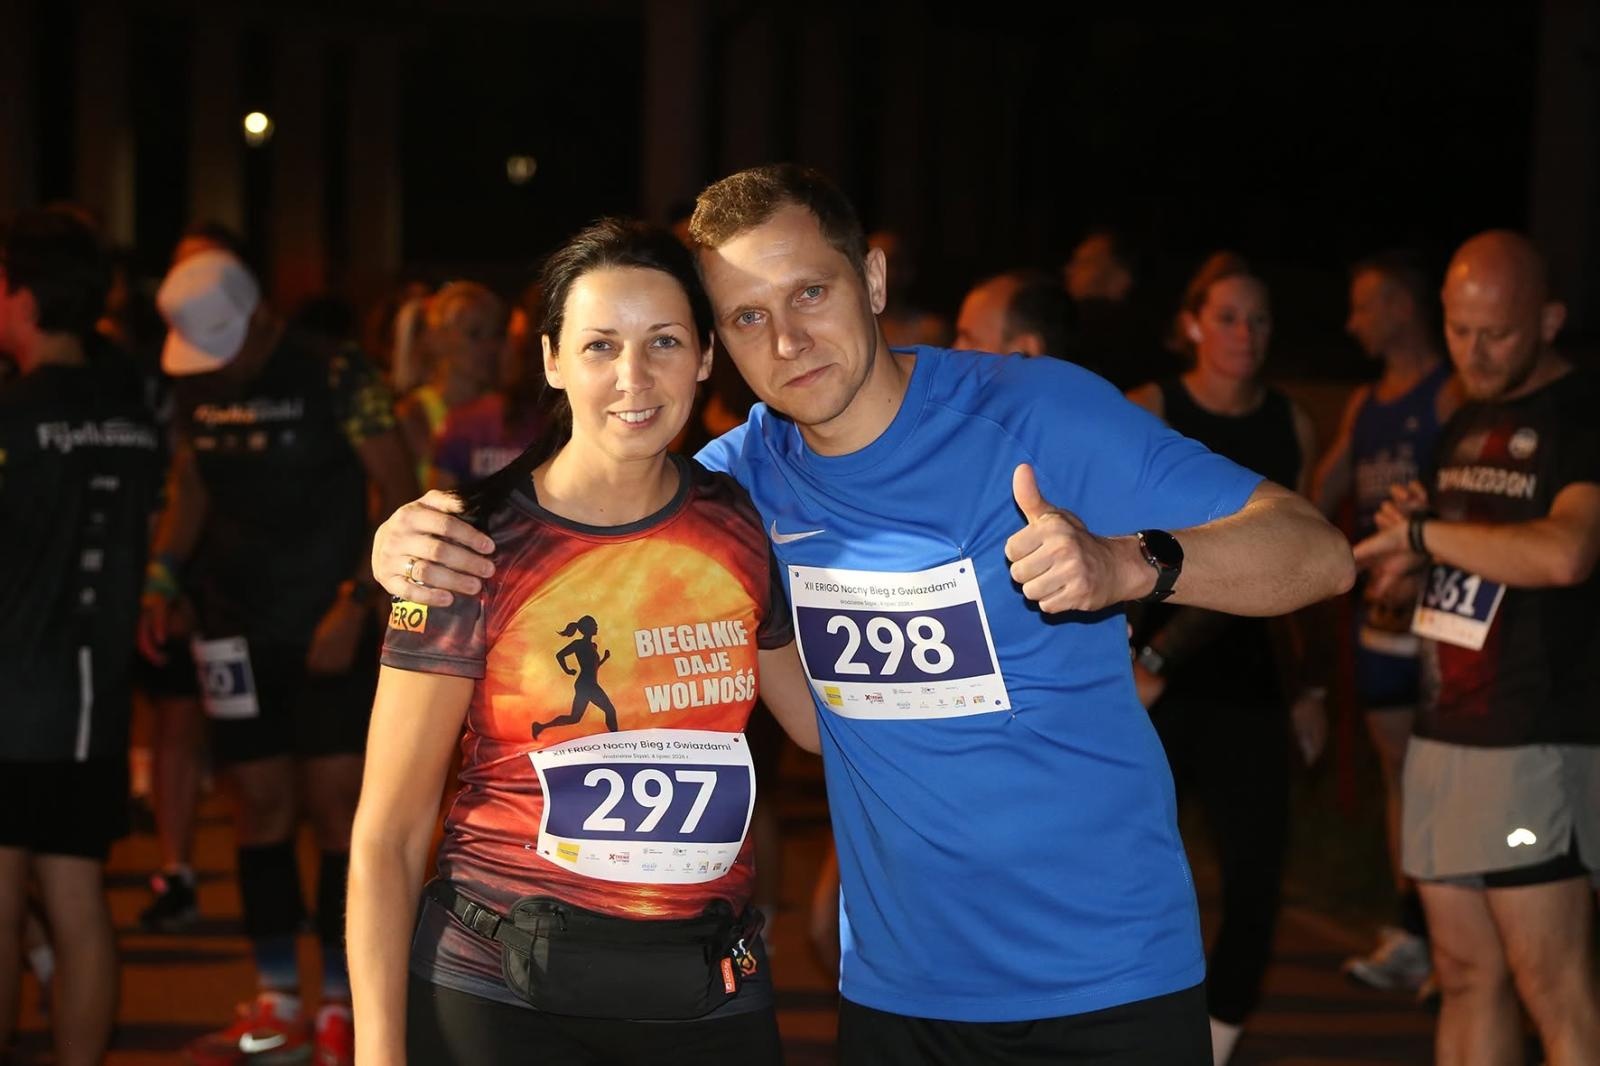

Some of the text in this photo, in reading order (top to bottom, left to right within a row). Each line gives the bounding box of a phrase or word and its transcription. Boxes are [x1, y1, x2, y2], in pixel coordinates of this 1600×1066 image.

[804, 581, 814, 591] XII
[815, 582, 839, 593] ERIGO
[841, 584, 868, 597] Nocny
[870, 585, 890, 598] Bieg
[898, 578, 957, 596] Gwiazdami
[1427, 566, 1482, 616] 361
[634, 619, 749, 659] BIEGANIE
[826, 614, 955, 676] 298
[673, 651, 732, 677] DAJE
[644, 667, 756, 714] WOLNOŚĆ
[567, 743, 601, 753] ERIGO
[603, 741, 638, 751] Nocny
[640, 739, 664, 751] Bieg
[673, 741, 732, 751] Gwiazdami
[582, 768, 718, 834] 297
